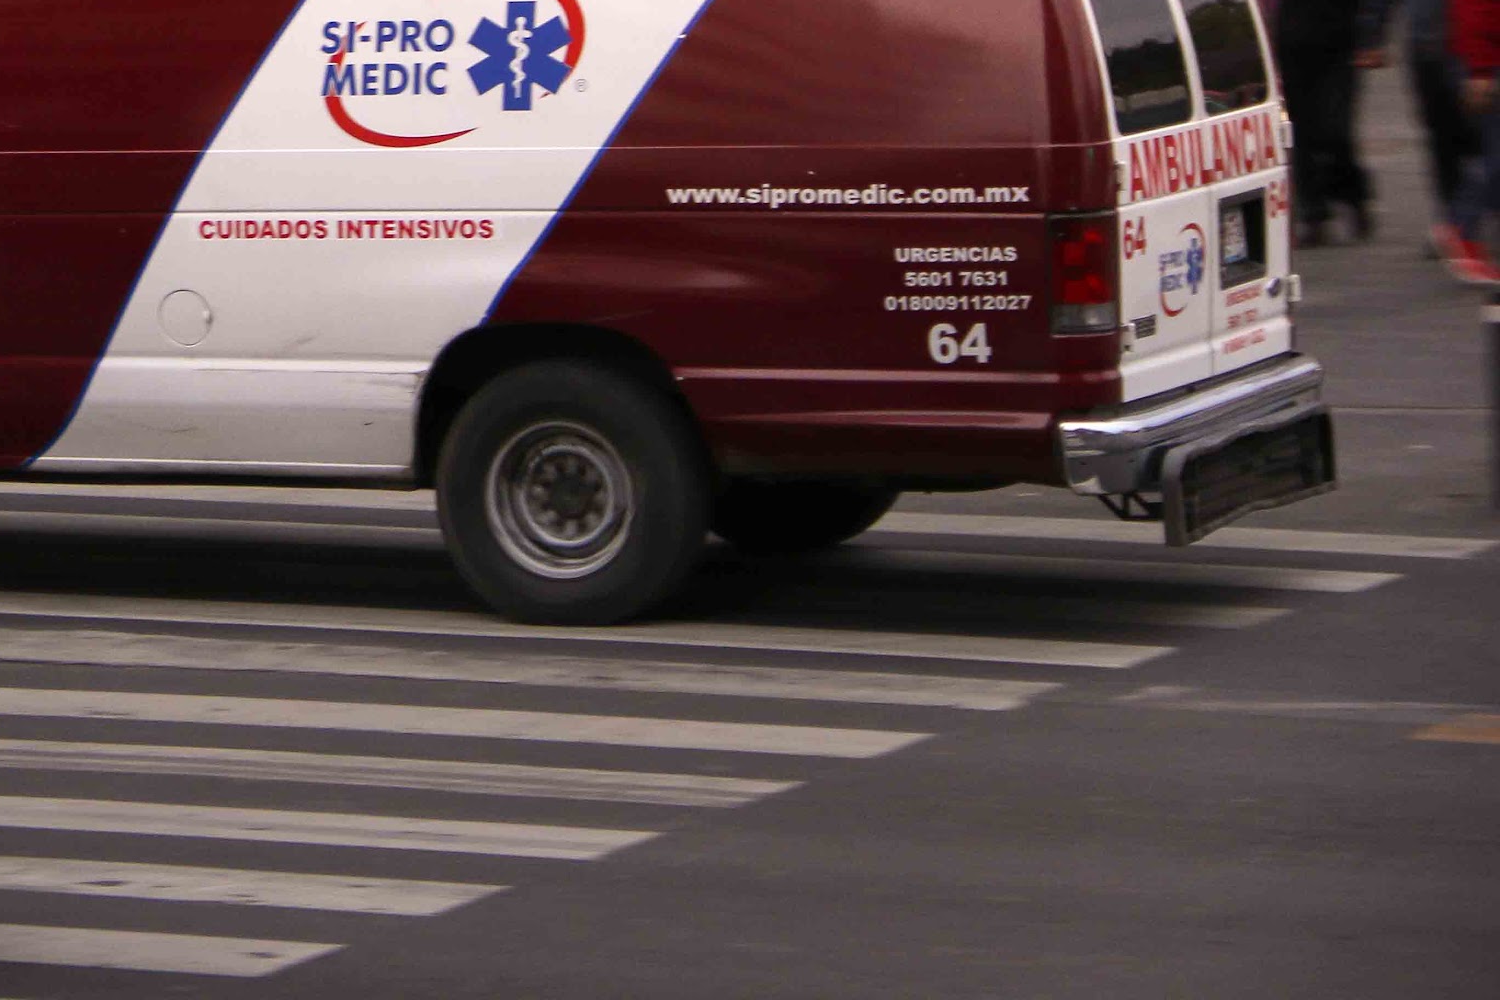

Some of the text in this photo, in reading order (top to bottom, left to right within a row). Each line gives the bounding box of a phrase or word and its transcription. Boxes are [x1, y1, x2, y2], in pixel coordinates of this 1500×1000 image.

[320, 19, 455, 54] SI-PRO
[321, 62, 449, 97] MEDIC
[1130, 112, 1277, 202] AMBULANCIA
[666, 184, 1030, 208] www.sipromedic.com.mx
[199, 219, 494, 240] CUIDADOS INTENSIVOS
[1123, 216, 1146, 260] 64
[894, 247, 1018, 263] URGENCIAS
[904, 271, 1008, 287] 5601 7631
[884, 295, 1032, 311] 018009112027
[928, 324, 992, 363] 64
